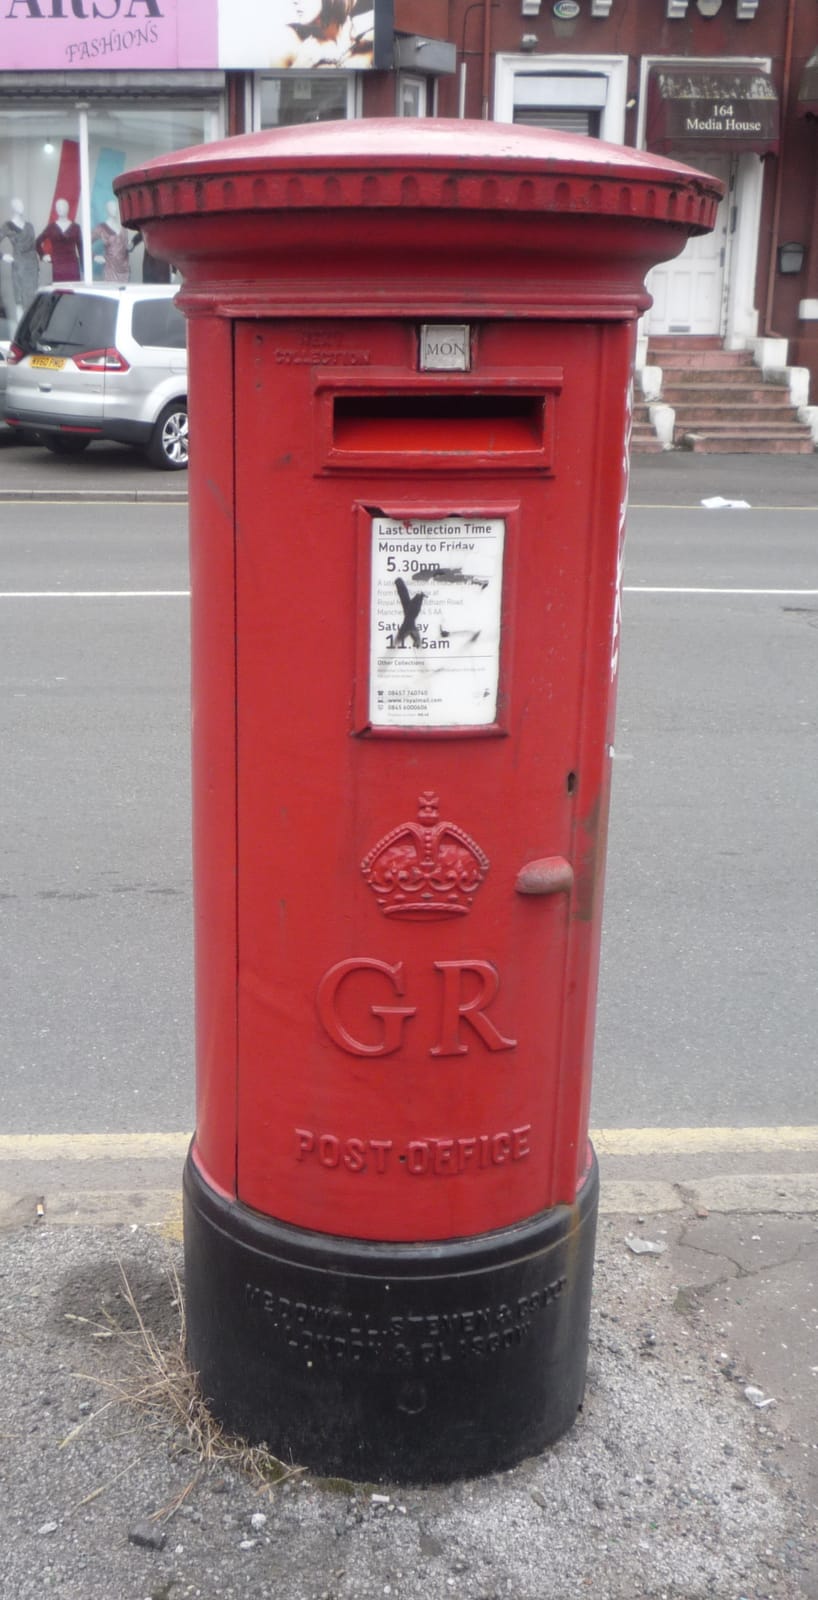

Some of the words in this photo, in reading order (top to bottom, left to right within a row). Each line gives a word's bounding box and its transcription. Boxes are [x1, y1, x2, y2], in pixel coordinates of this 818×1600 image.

[66, 21, 159, 62] FASHIONS
[713, 105, 733, 116] 164
[686, 119, 722, 130] Media
[725, 119, 761, 131] House
[426, 343, 465, 355] MON
[274, 349, 373, 366] COLLECTION
[378, 525, 403, 535] Last
[406, 524, 461, 535] Collection
[464, 523, 492, 534] Time
[378, 541, 423, 554] Monday
[425, 542, 437, 552] to
[440, 541, 475, 552] Friday
[386, 556, 441, 572] 5.30pm
[316, 957, 518, 1057] GR
[295, 1128, 393, 1174] POST
[407, 1124, 532, 1176] OFFICE
